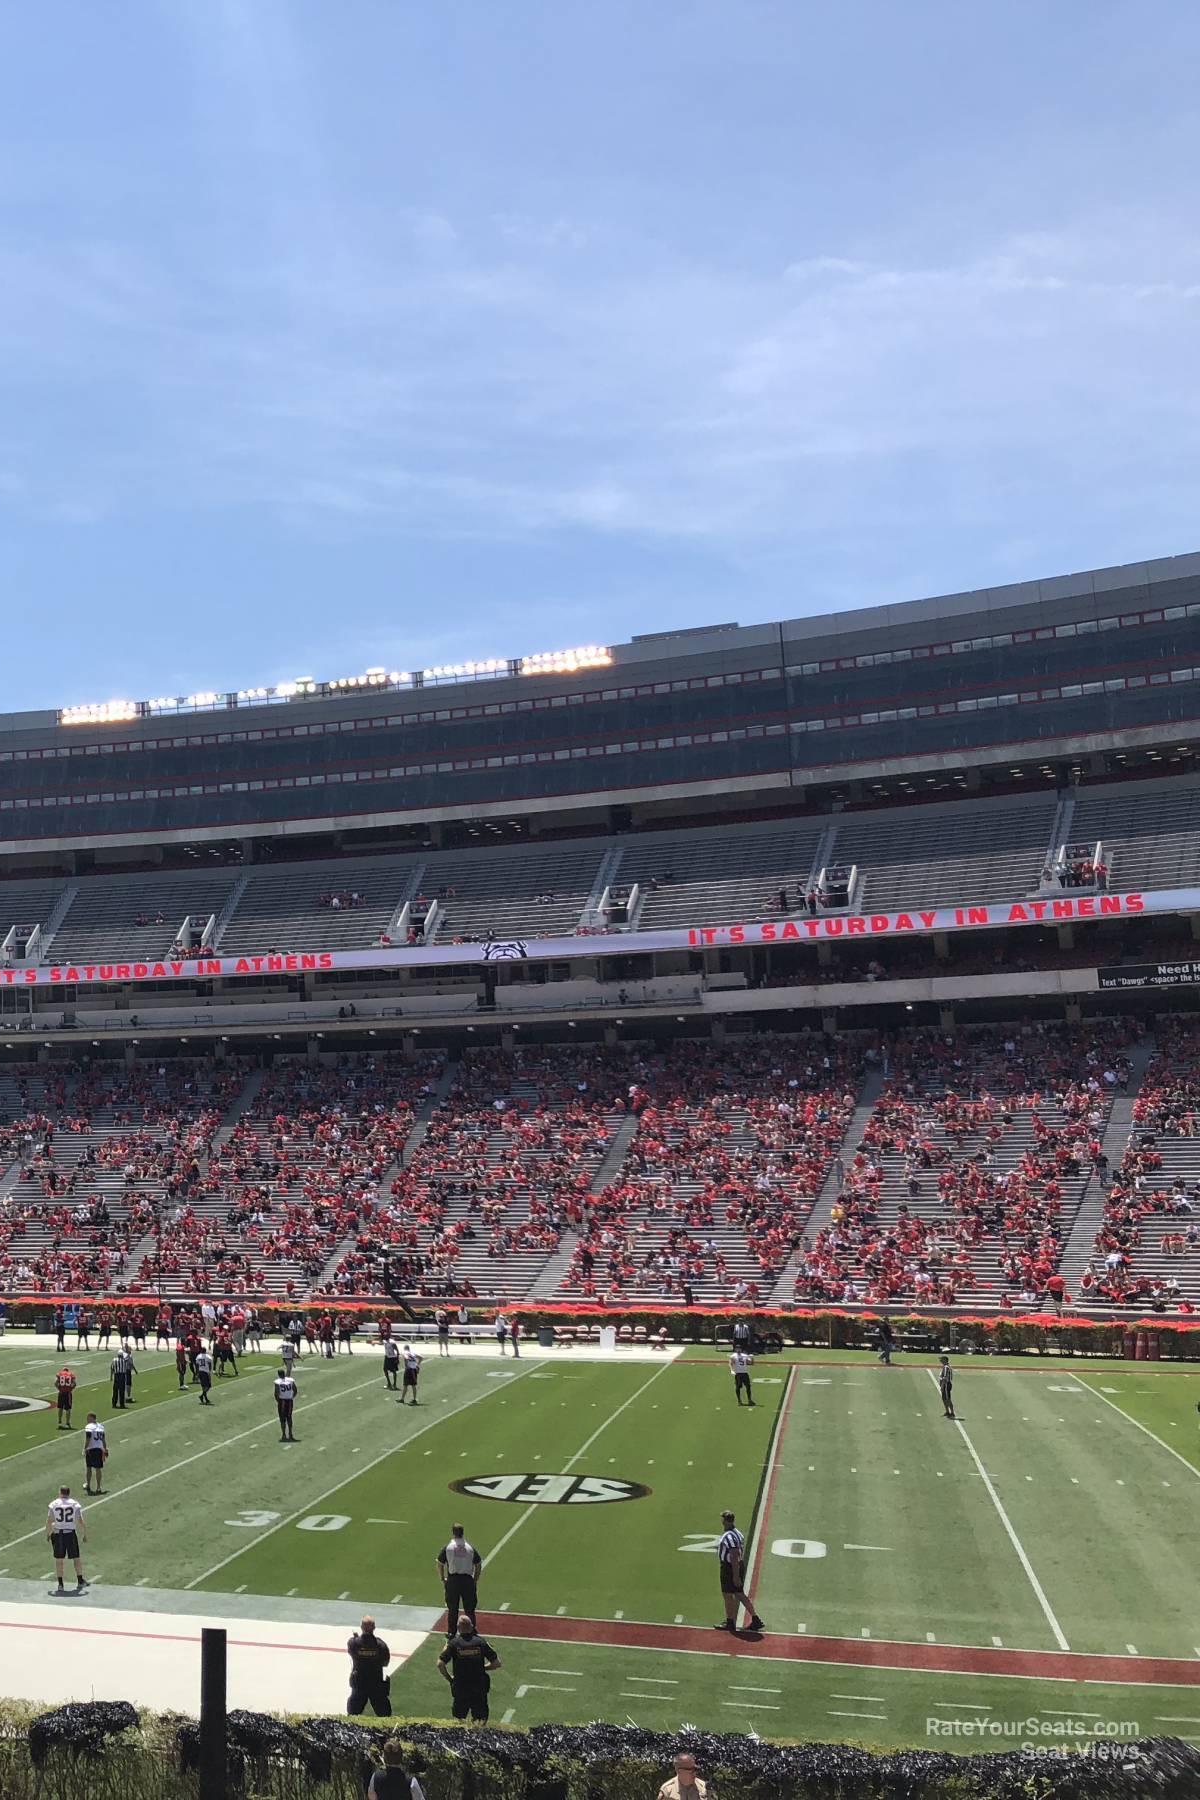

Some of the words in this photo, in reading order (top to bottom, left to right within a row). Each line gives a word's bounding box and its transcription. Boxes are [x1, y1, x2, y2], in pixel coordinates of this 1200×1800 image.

[688, 926, 745, 946] IT'S
[761, 911, 937, 940] SATURDAY
[955, 907, 989, 925] IN
[1008, 894, 1144, 921] ATHENS
[50, 961, 184, 981] SATURDAY
[197, 960, 221, 975] IN
[235, 953, 333, 972] ATHENS
[1158, 964, 1190, 974] Need
[1102, 978, 1117, 987] Text
[1180, 974, 1192, 982] the
[59, 1375, 72, 1386] 83
[55, 1507, 74, 1522] 32
